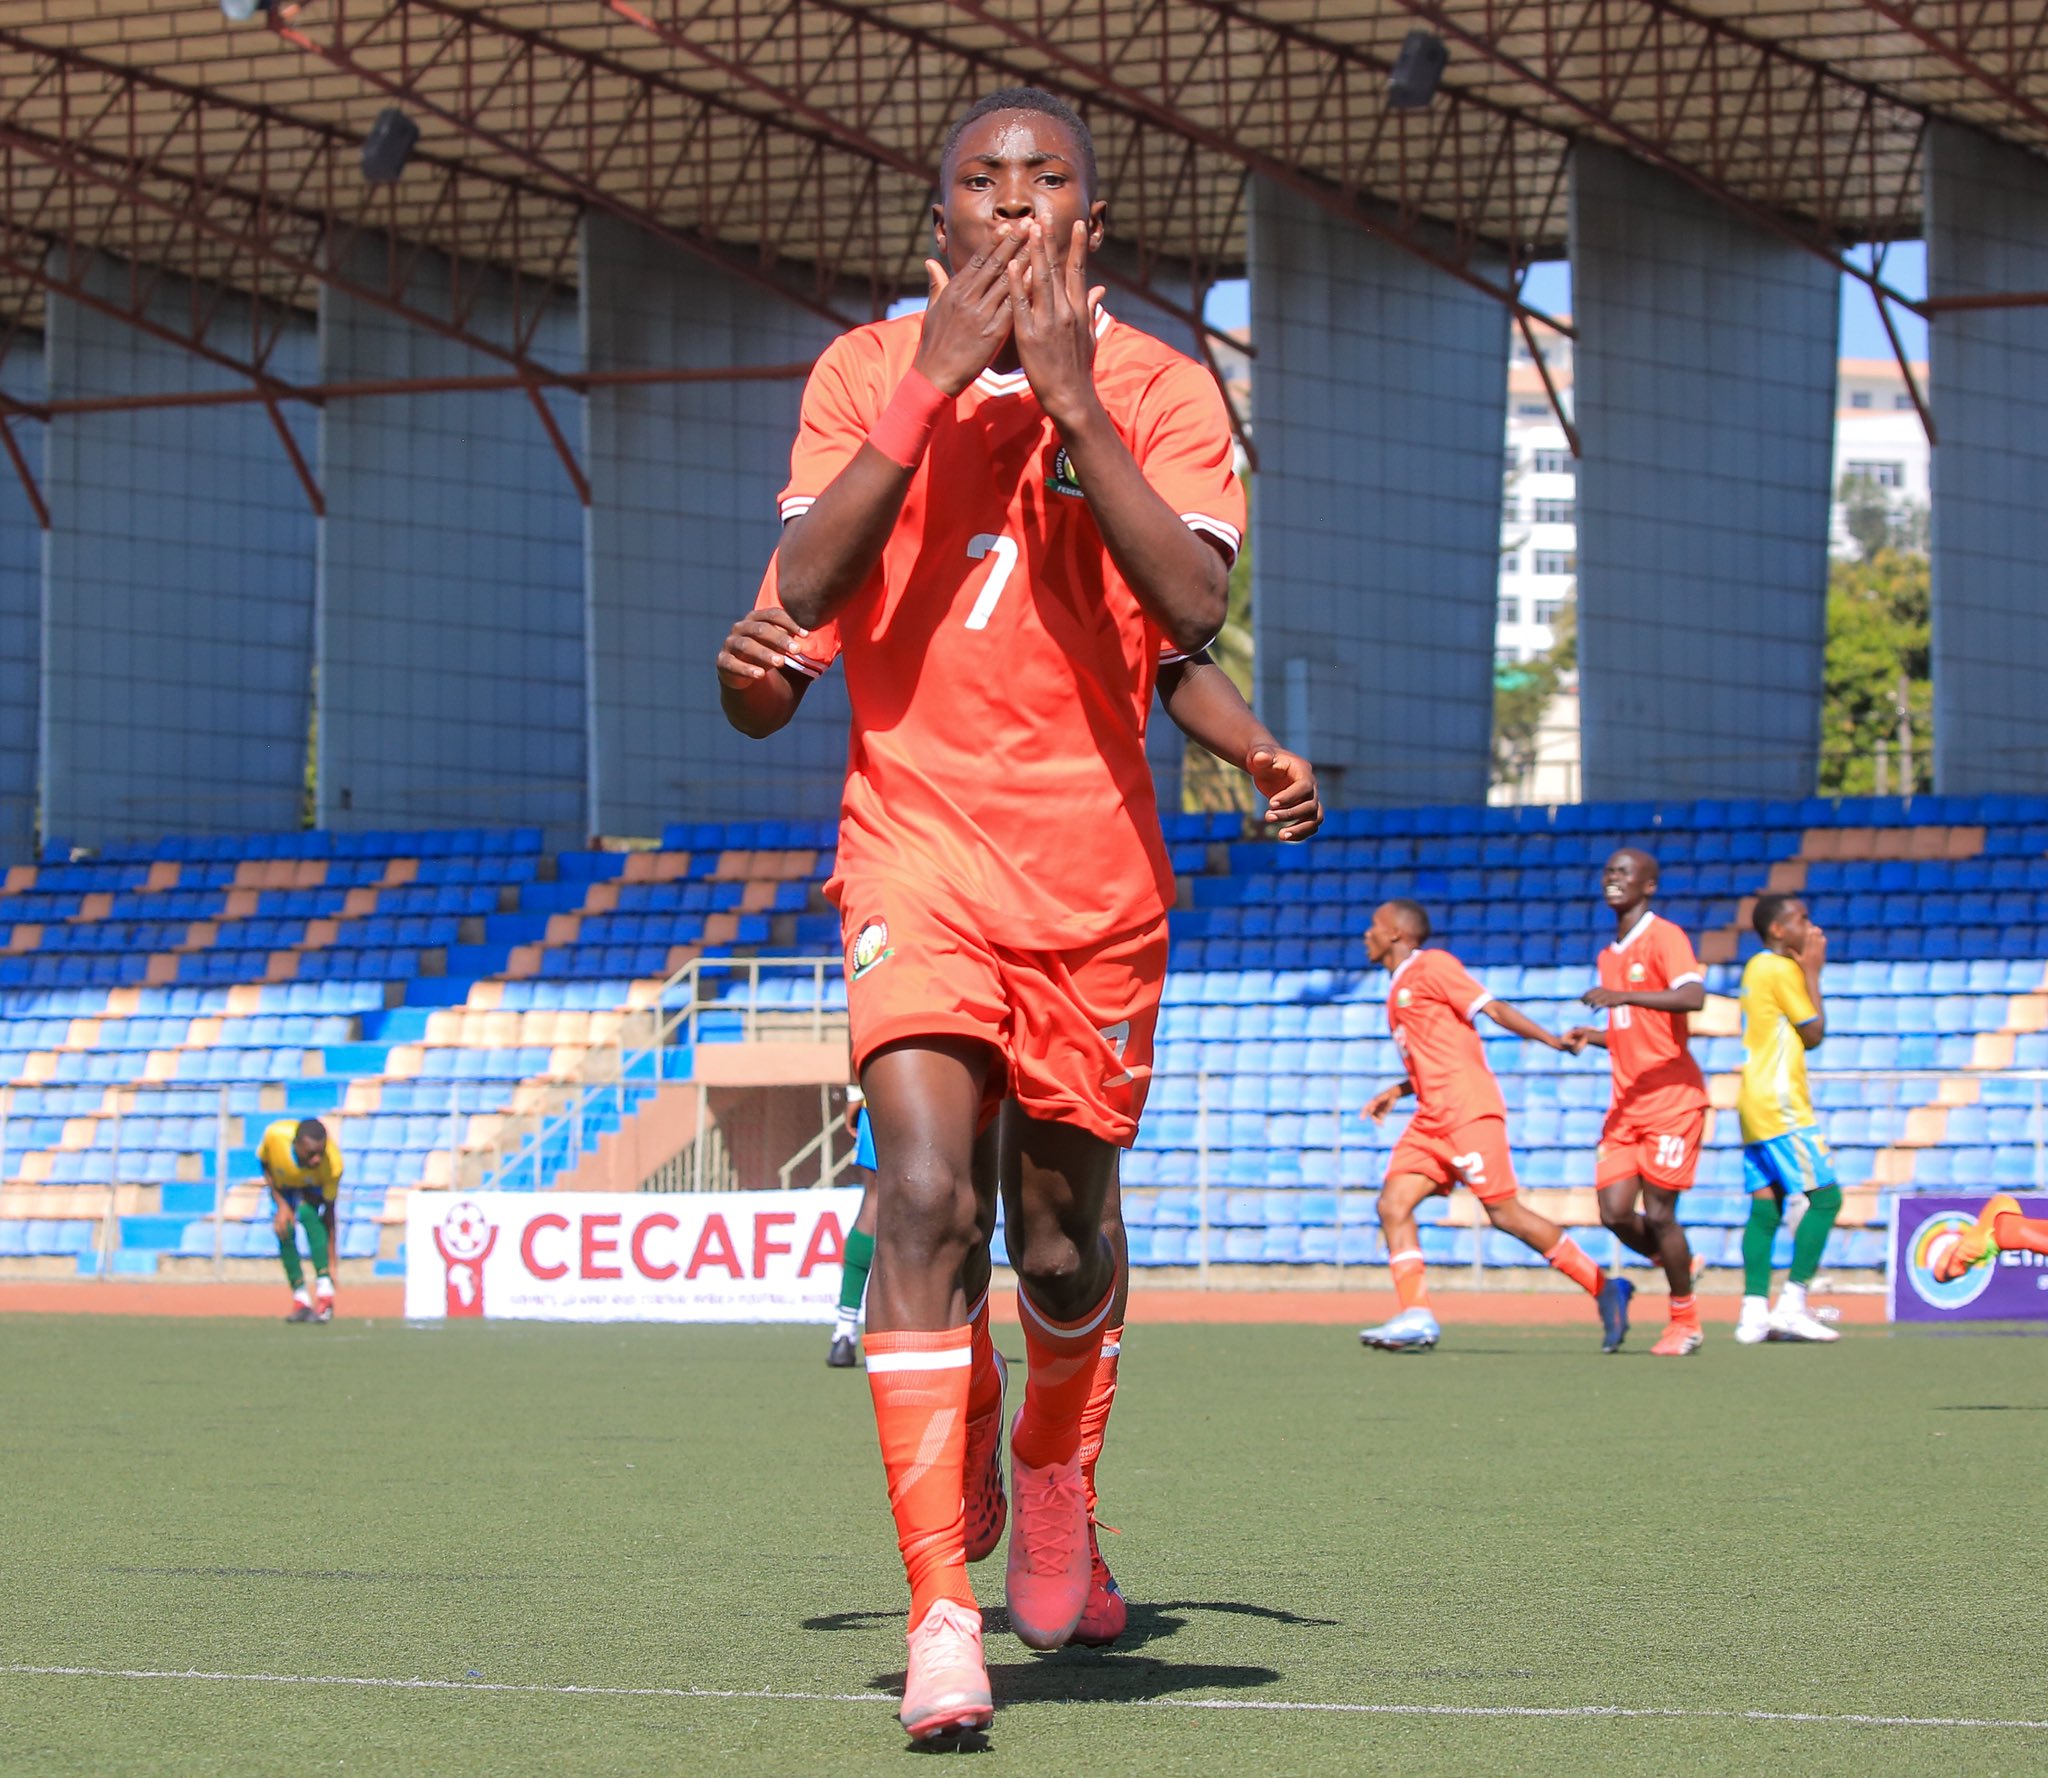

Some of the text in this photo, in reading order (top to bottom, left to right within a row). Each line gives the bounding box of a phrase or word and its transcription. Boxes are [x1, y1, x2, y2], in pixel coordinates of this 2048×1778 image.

[964, 533, 1019, 631] 7
[1452, 1151, 1487, 1184] 2
[1655, 1134, 1685, 1168] 10
[520, 1211, 847, 1280] CECAFA
